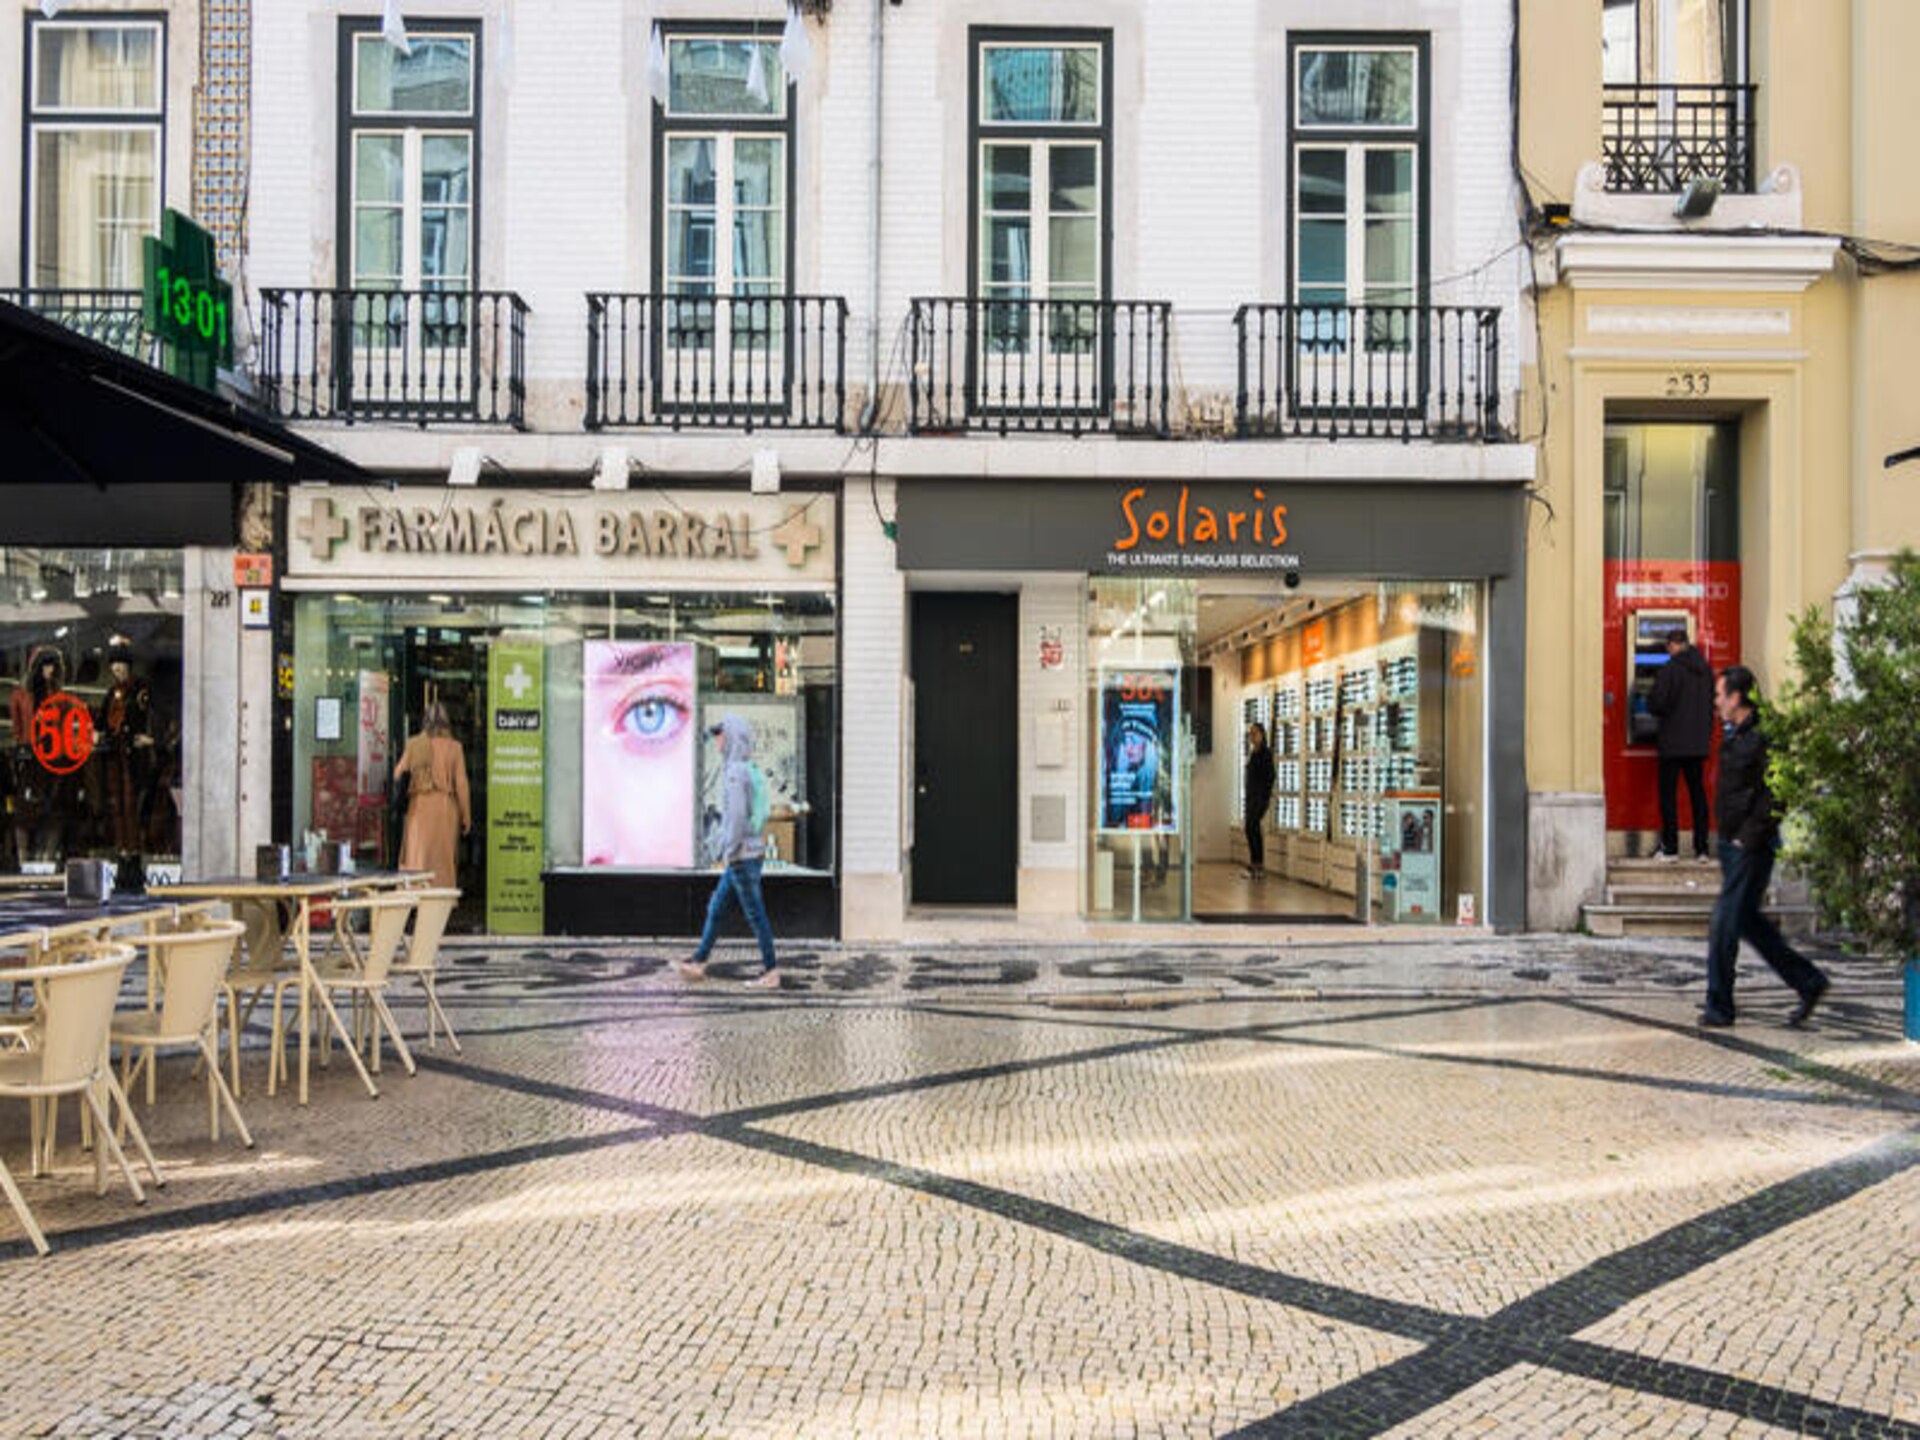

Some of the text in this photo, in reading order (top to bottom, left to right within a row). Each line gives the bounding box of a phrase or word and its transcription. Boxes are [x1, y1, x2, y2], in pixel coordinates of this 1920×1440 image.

[157, 266, 226, 347] 13:01
[1665, 373, 1709, 395] 233
[357, 498, 760, 560] FARMÁCIA BARRAL
[1115, 485, 1287, 550] Solaris
[1107, 554, 1300, 567] THE ULTIMATE SUNGLASS SELECTION
[38, 705, 89, 760] 50
[498, 713, 538, 728] barral
